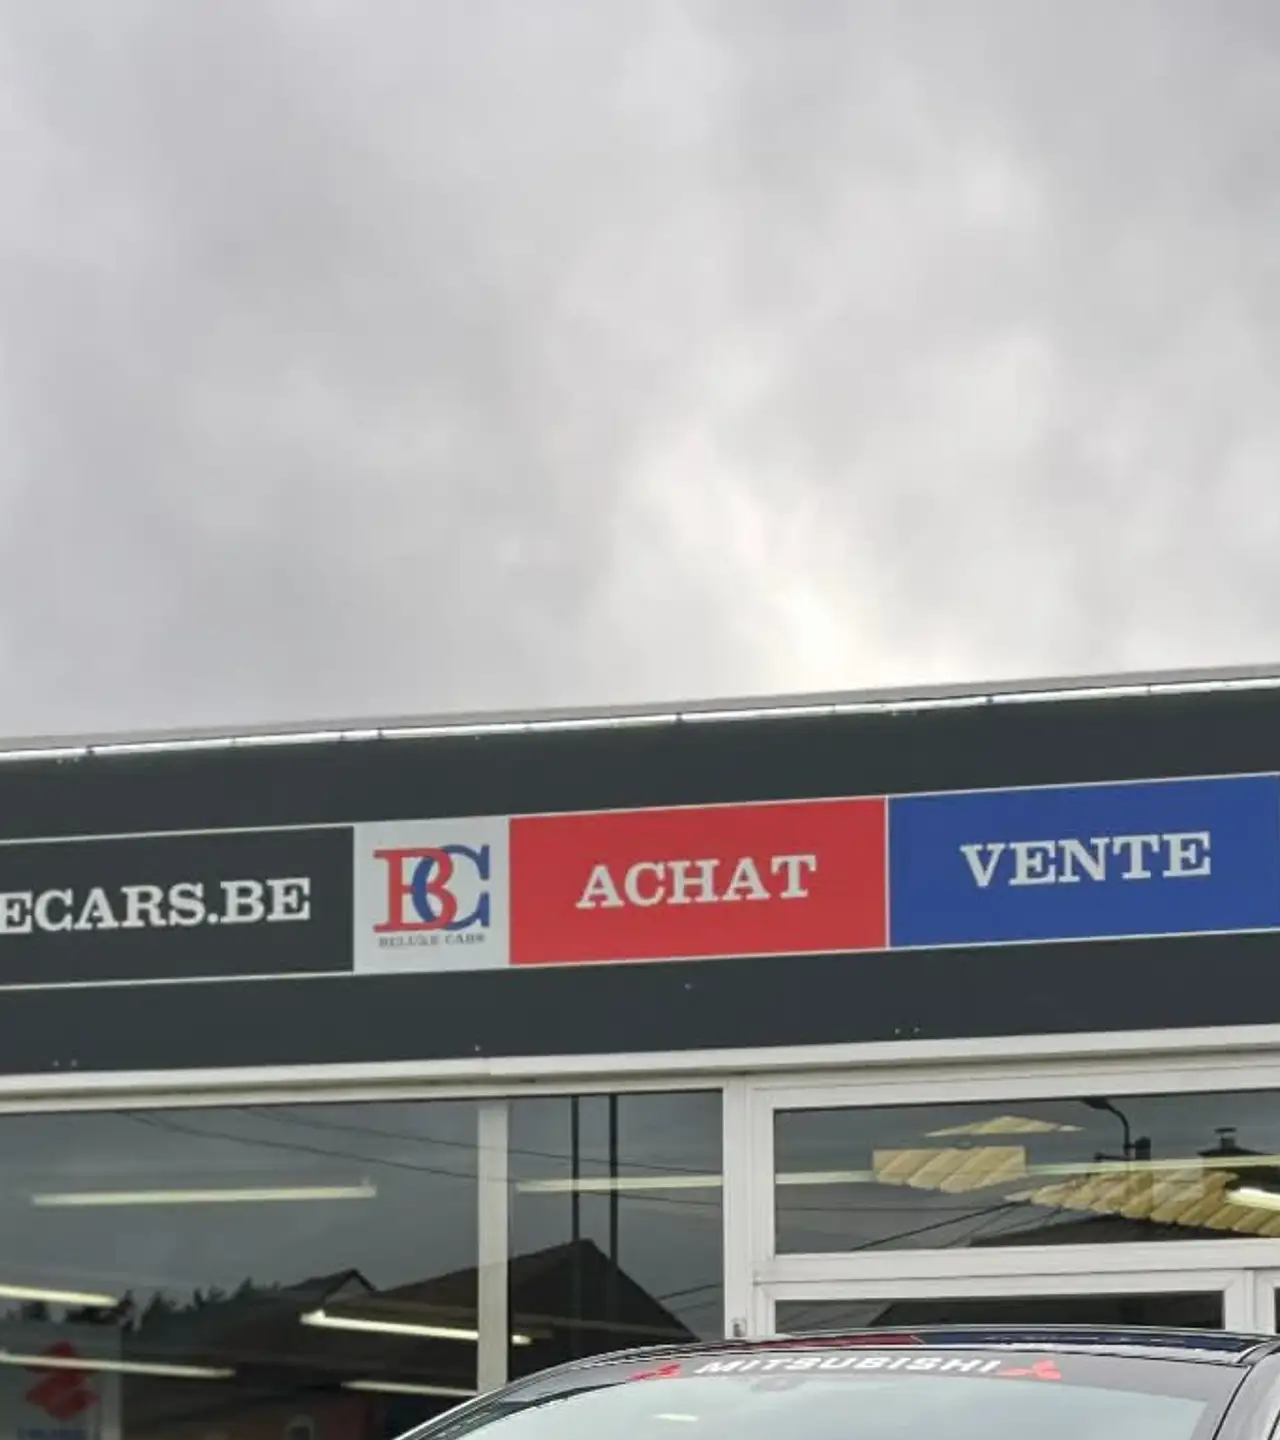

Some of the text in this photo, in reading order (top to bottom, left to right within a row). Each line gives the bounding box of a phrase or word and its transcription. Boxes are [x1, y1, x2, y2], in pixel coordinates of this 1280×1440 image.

[576, 855, 816, 909] ACHAT
[960, 832, 1211, 887] VENTE
[695, 1356, 1002, 1374] MITSUBISHI
